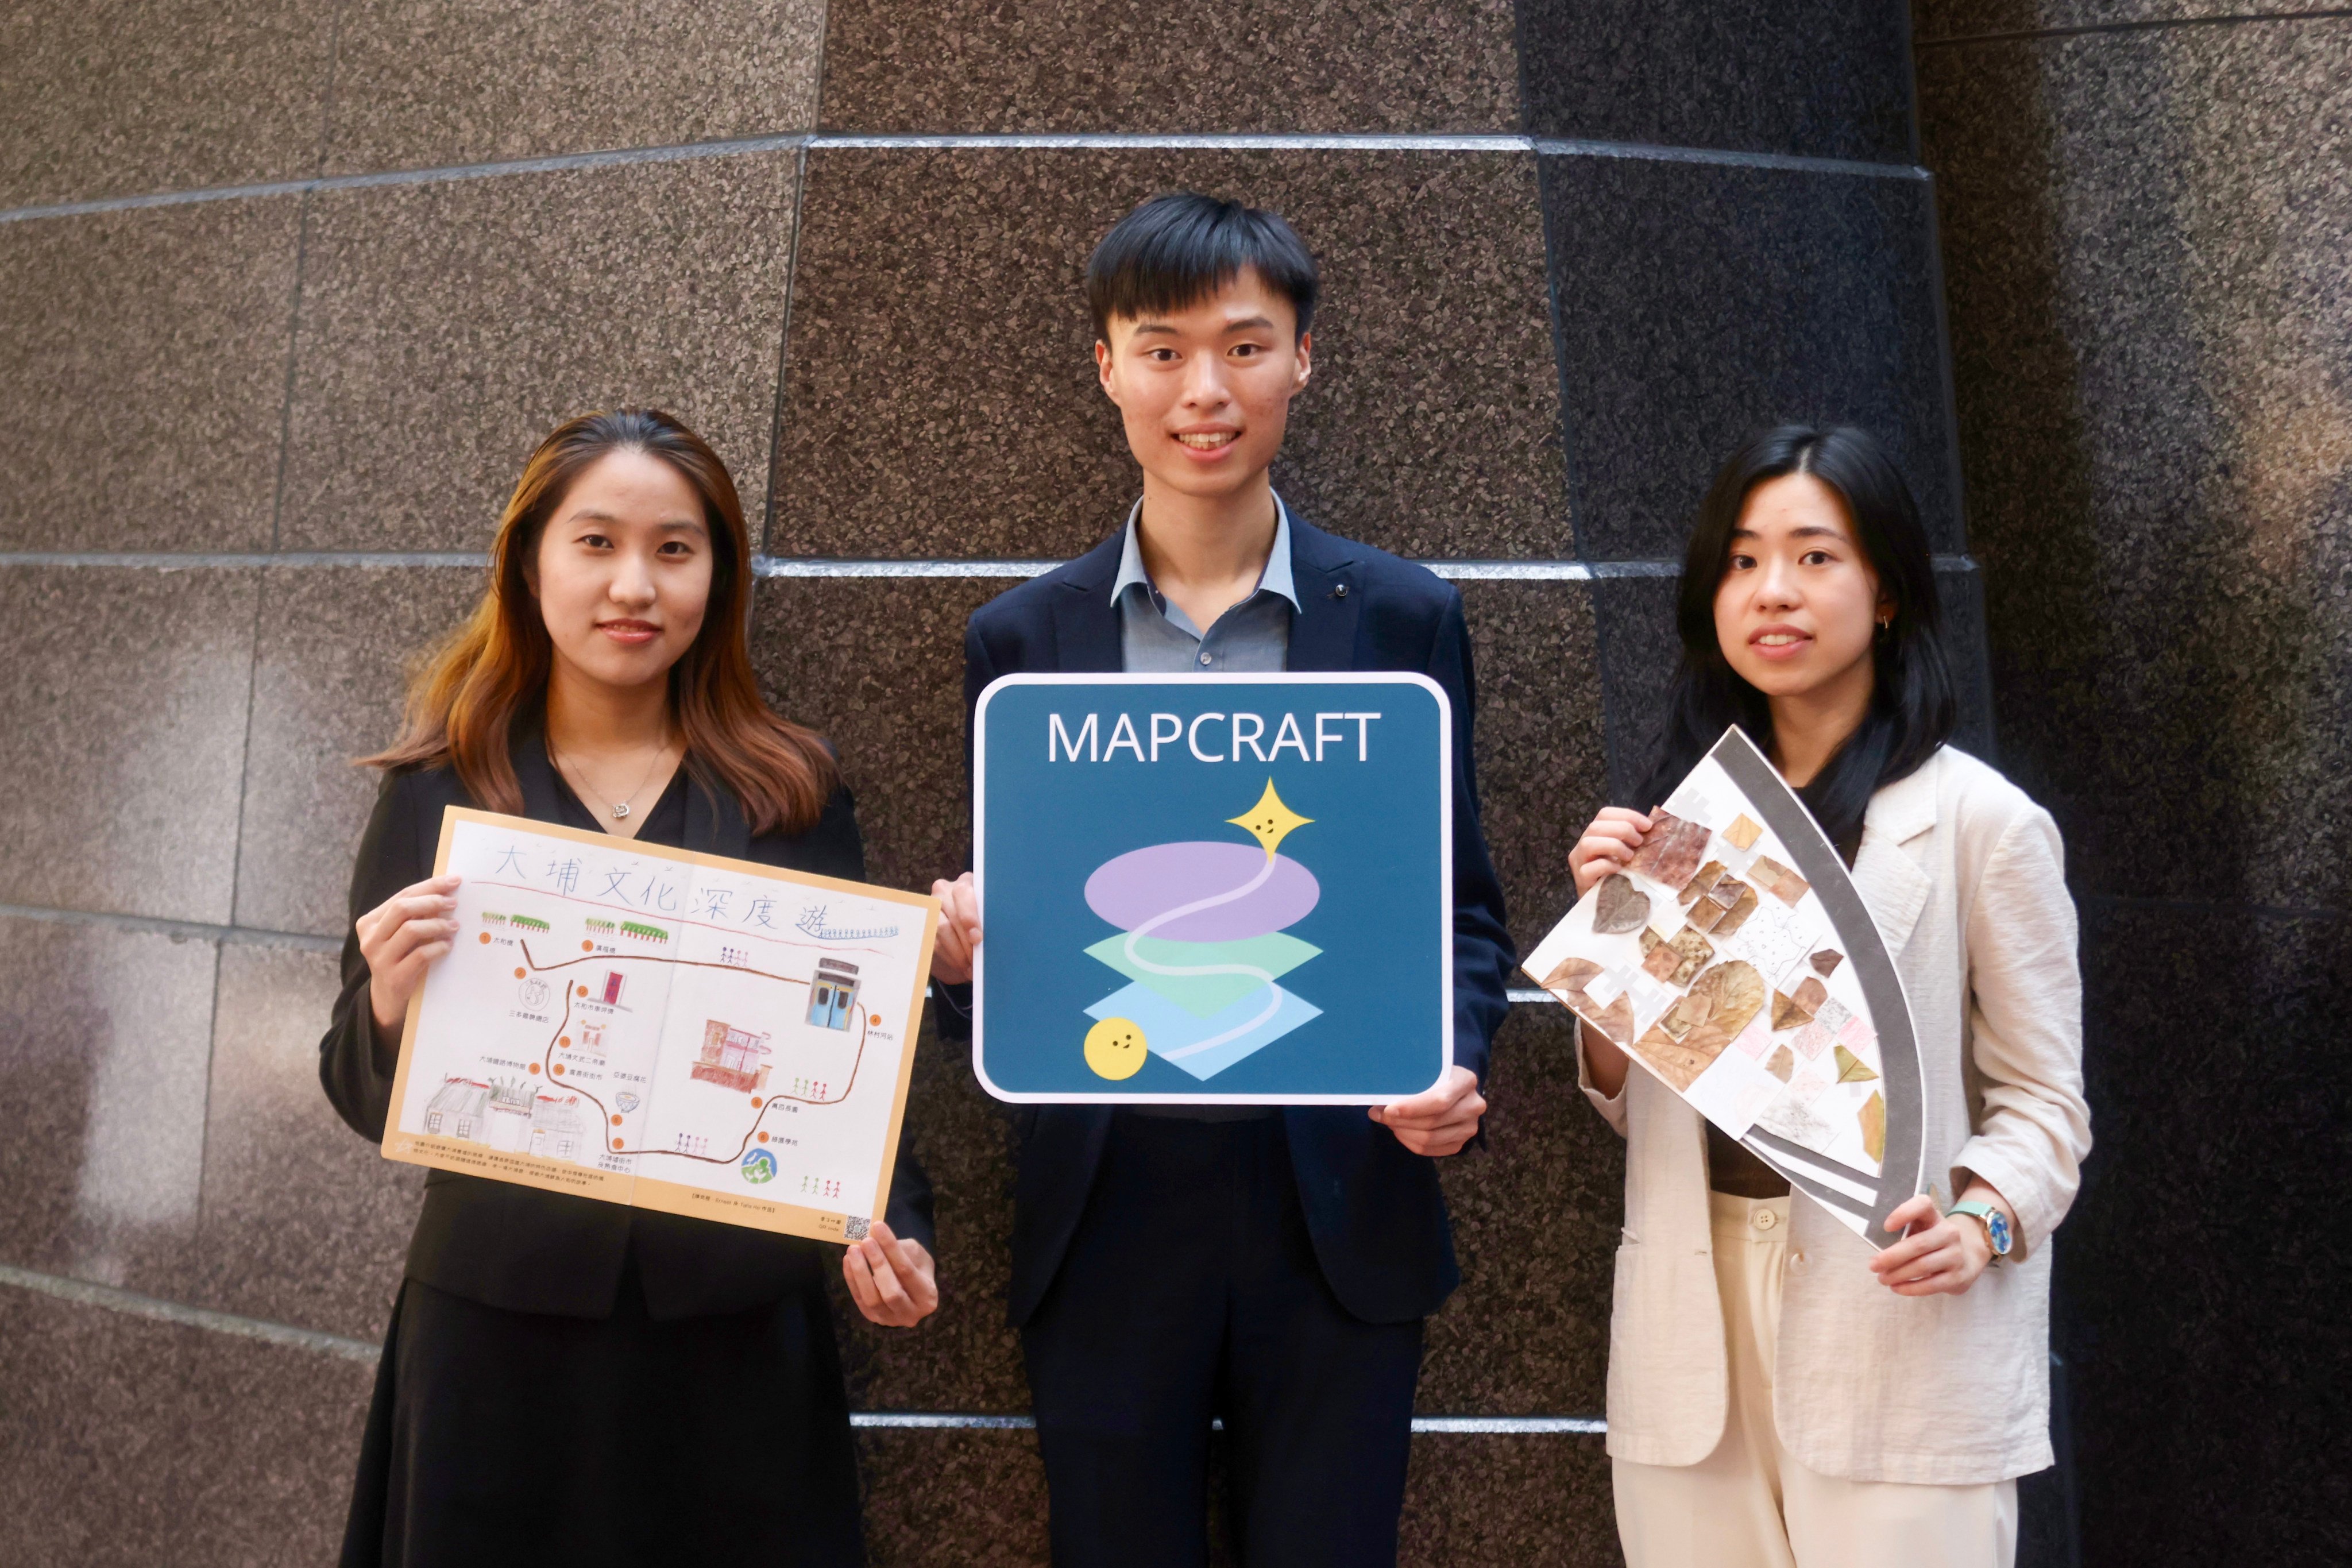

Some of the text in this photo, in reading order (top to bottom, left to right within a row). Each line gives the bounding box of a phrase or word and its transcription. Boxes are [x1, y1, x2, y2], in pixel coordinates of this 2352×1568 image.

[1049, 712, 1381, 763] MAPCRAFT
[495, 845, 898, 939] 大埔文化深度遊
[493, 937, 514, 947] 太和橋
